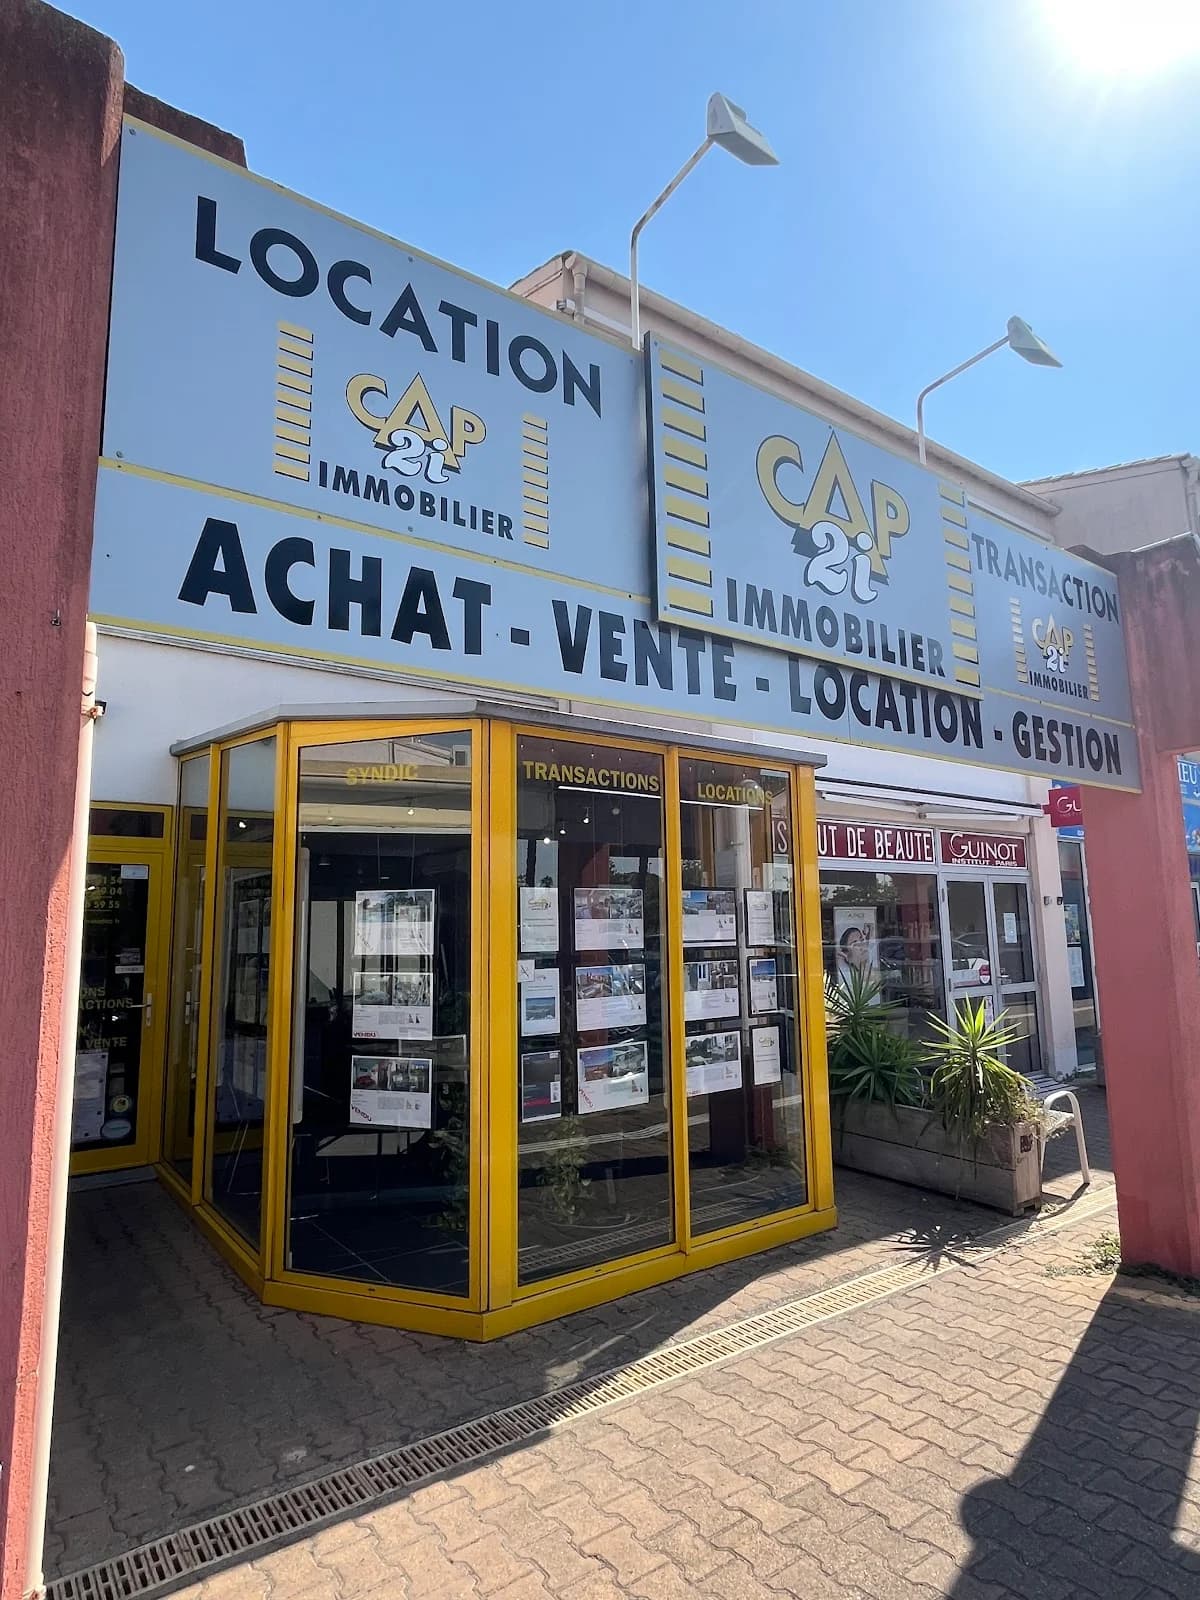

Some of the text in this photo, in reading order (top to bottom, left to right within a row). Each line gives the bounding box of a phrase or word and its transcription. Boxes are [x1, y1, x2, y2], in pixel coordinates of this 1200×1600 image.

[195, 194, 602, 418] LOCATION
[346, 371, 486, 474] CAP
[381, 428, 450, 484] 2i
[318, 460, 514, 540] IMMOBILIER
[756, 429, 911, 586] CAP
[804, 520, 879, 604] 2i
[971, 532, 1120, 624] TRANSACTION
[177, 516, 492, 656] ACHAT
[551, 599, 738, 702] VENTE
[787, 654, 985, 750] LOCATION
[1012, 710, 1123, 776] GESTION
[725, 577, 946, 678] IMMOBILIER
[1031, 612, 1074, 666] CAP
[1029, 670, 1089, 699] IMMOBILIER
[1046, 645, 1066, 673] 2i
[345, 763, 419, 786] SYNDIC
[522, 760, 660, 793] TRANSACTIONS
[697, 782, 773, 805] LOCATIONS
[846, 826, 868, 858] DE
[874, 828, 933, 861] BEAUTE
[948, 832, 1018, 861] GUINOT
